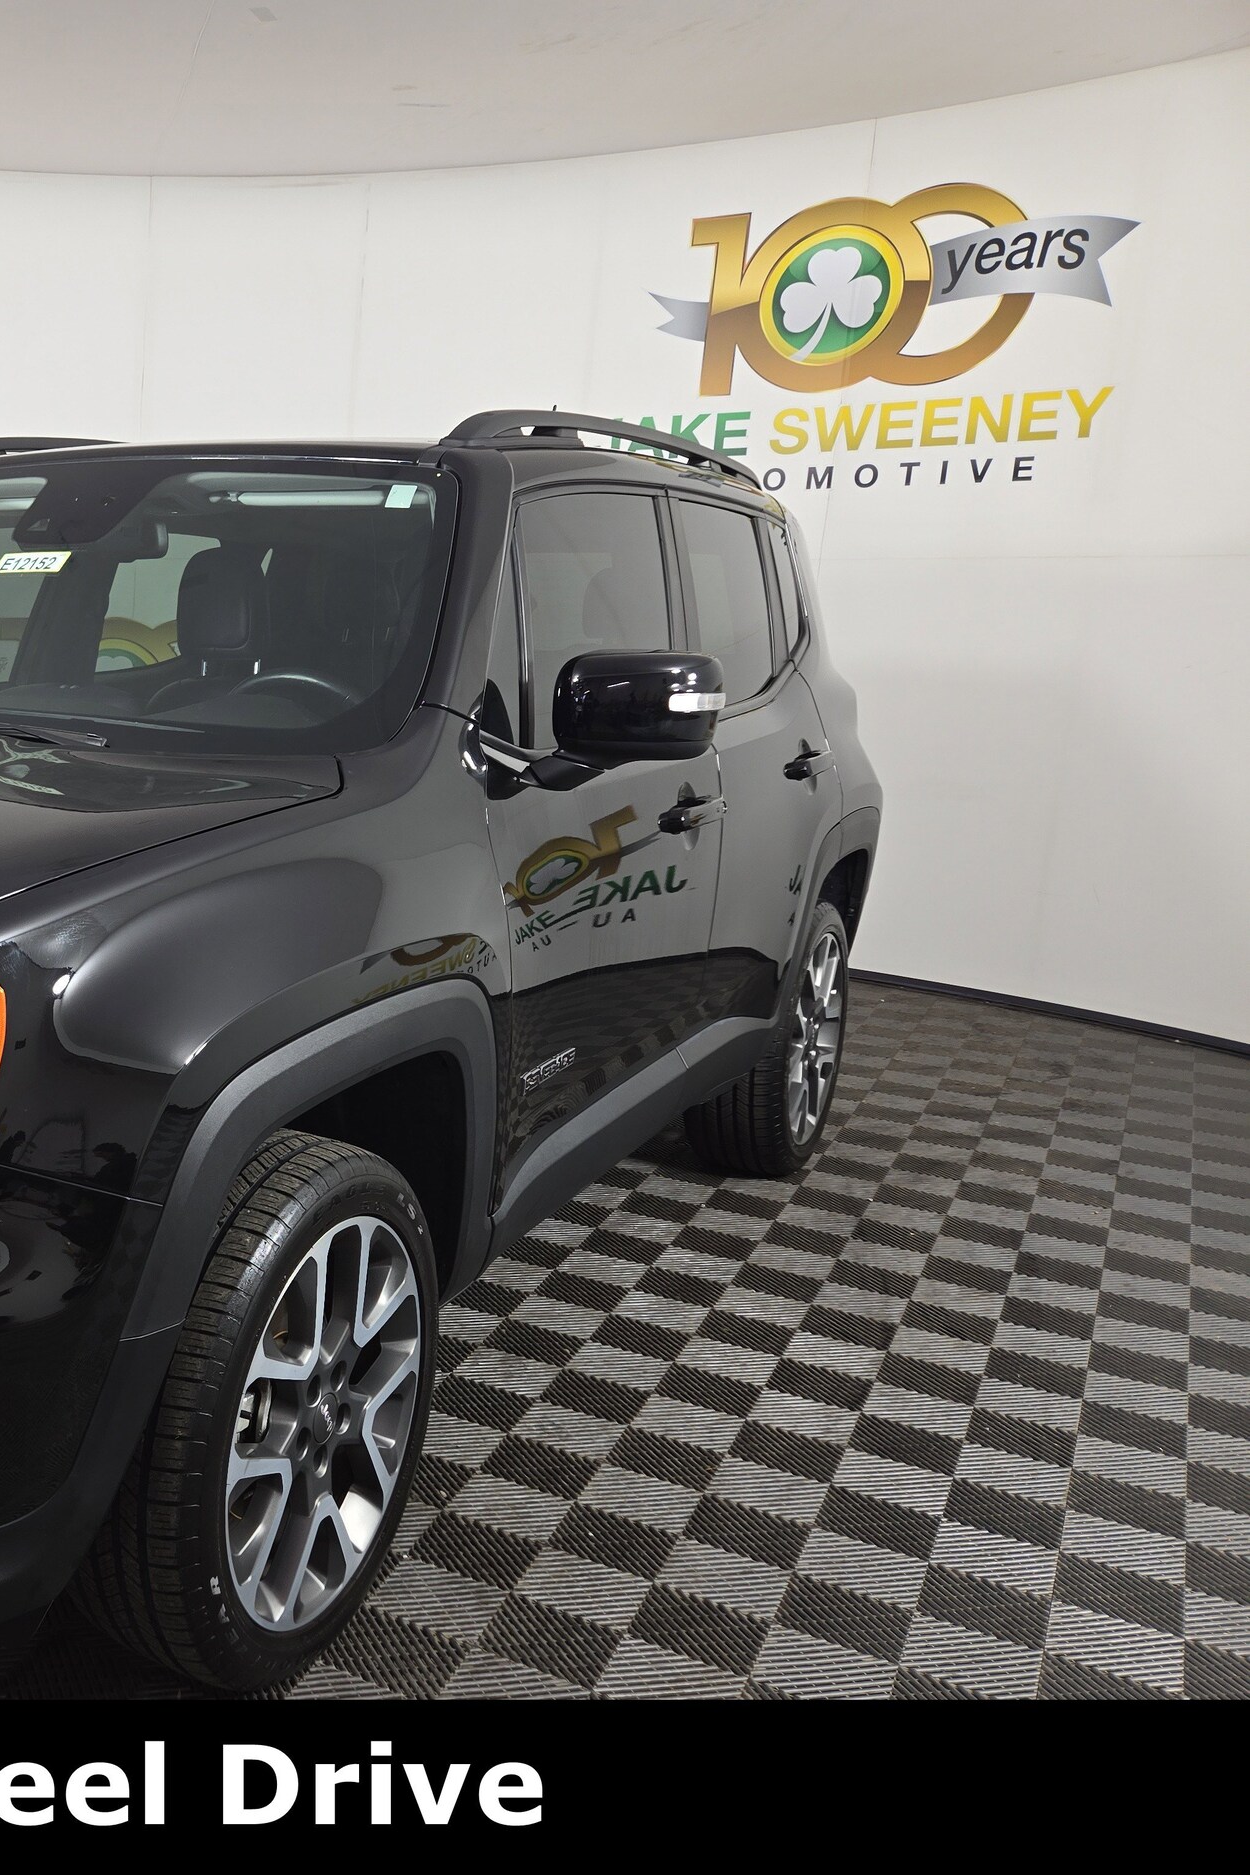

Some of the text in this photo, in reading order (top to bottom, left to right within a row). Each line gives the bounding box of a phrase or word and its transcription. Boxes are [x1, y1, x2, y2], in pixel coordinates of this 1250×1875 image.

[941, 225, 1089, 294] years
[769, 386, 1115, 456] SWEENEY
[762, 456, 1035, 491] OMOTIVE
[0, 555, 58, 572] E12152
